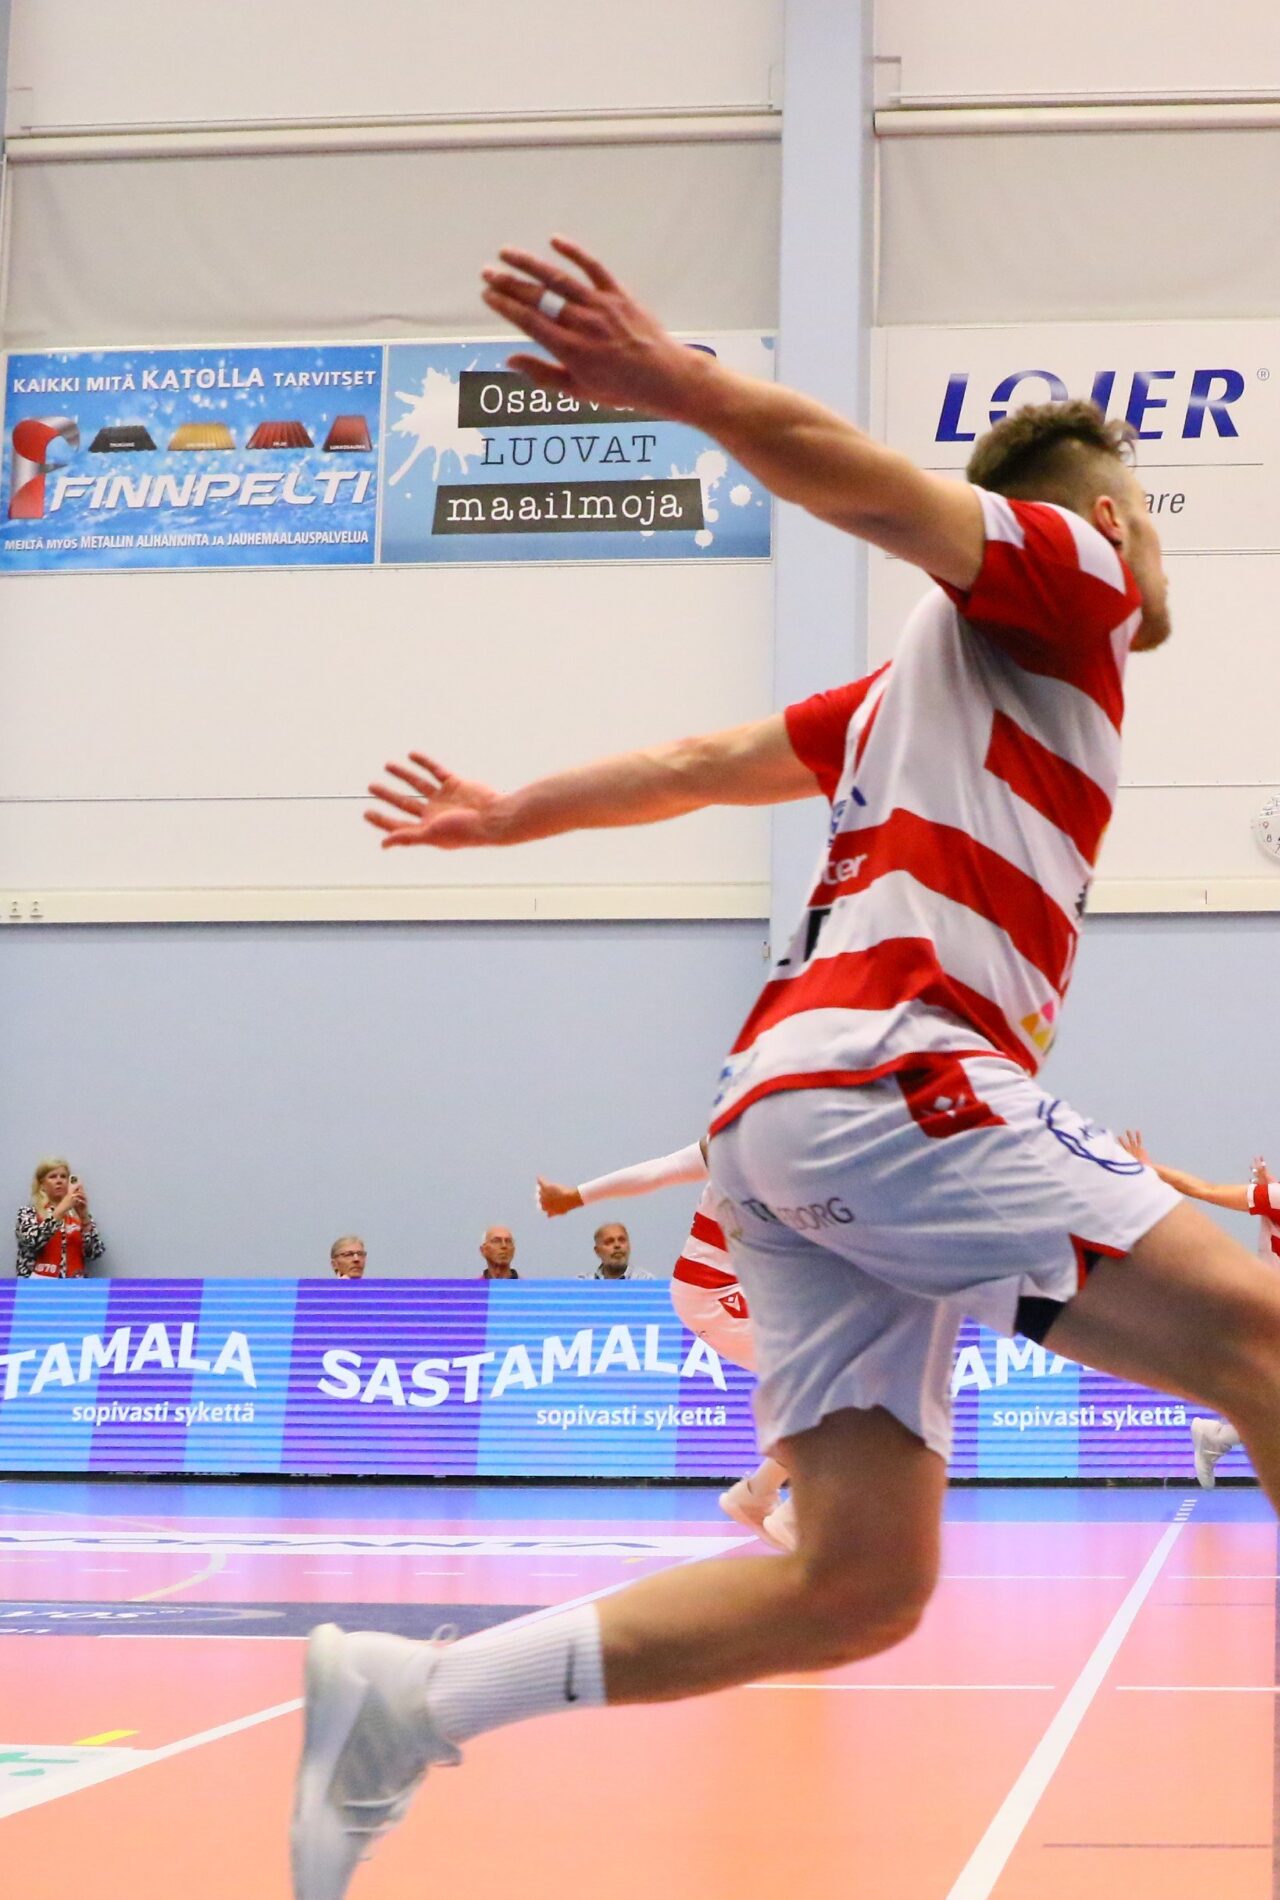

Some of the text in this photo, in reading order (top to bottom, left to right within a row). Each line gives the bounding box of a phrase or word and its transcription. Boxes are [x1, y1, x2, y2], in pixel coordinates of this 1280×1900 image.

[14, 367, 376, 393] KAIKKI MITÄ KATOLLA TARVITSET
[480, 383, 634, 415] Osaa
[481, 434, 656, 466] LUOVAT
[50, 471, 372, 511] FINNPELTI
[447, 490, 683, 527] maailmoja
[5, 539, 43, 551] MEILTÄ
[81, 535, 134, 549] METALLIN
[136, 533, 209, 548] ALIHANKINTA
[212, 536, 224, 546] JA
[227, 531, 369, 546] JAUHEMAALAUSPALVELUA
[315, 1324, 728, 1408] SASTAMALA
[71, 1401, 255, 1427] sopivasti sykettä
[536, 1404, 726, 1431] sopivasti sykettä
[992, 1404, 1186, 1431] sopivasti sykettä
